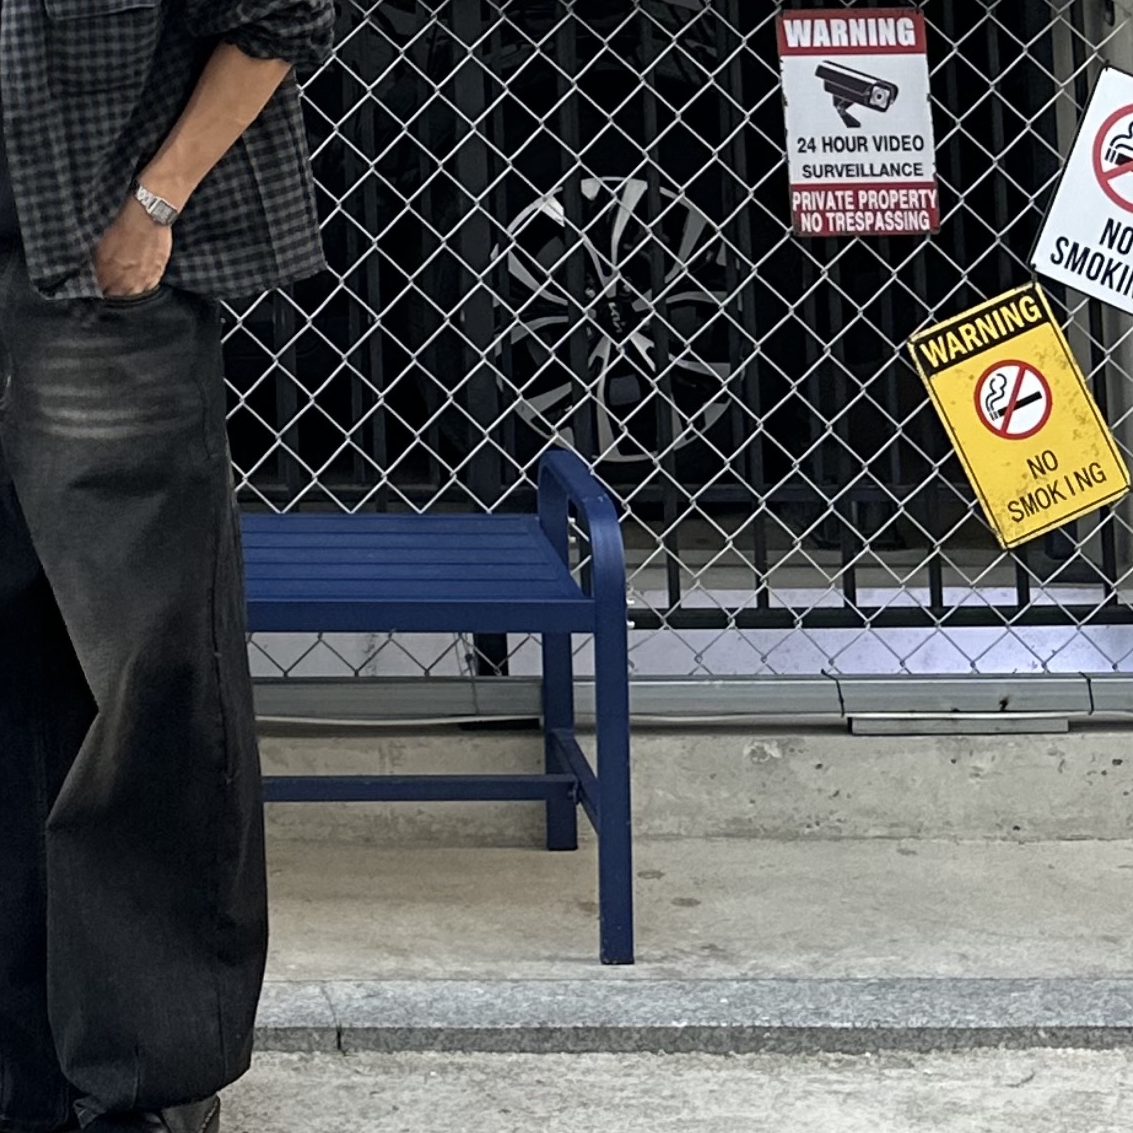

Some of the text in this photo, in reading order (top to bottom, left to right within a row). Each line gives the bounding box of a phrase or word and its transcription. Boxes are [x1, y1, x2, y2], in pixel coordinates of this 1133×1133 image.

[782, 17, 916, 48] WARNING
[797, 134, 925, 154] 24 HOUR VIDEO
[801, 162, 924, 179] SURVEILLANCE
[792, 188, 938, 212] PRIVATE PROPERTY
[800, 210, 931, 232] NO TRESPASSING
[1098, 217, 1133, 257] NO
[919, 295, 1043, 368] WARNING
[1025, 449, 1059, 480] NO
[1006, 461, 1108, 523] SMOKING
